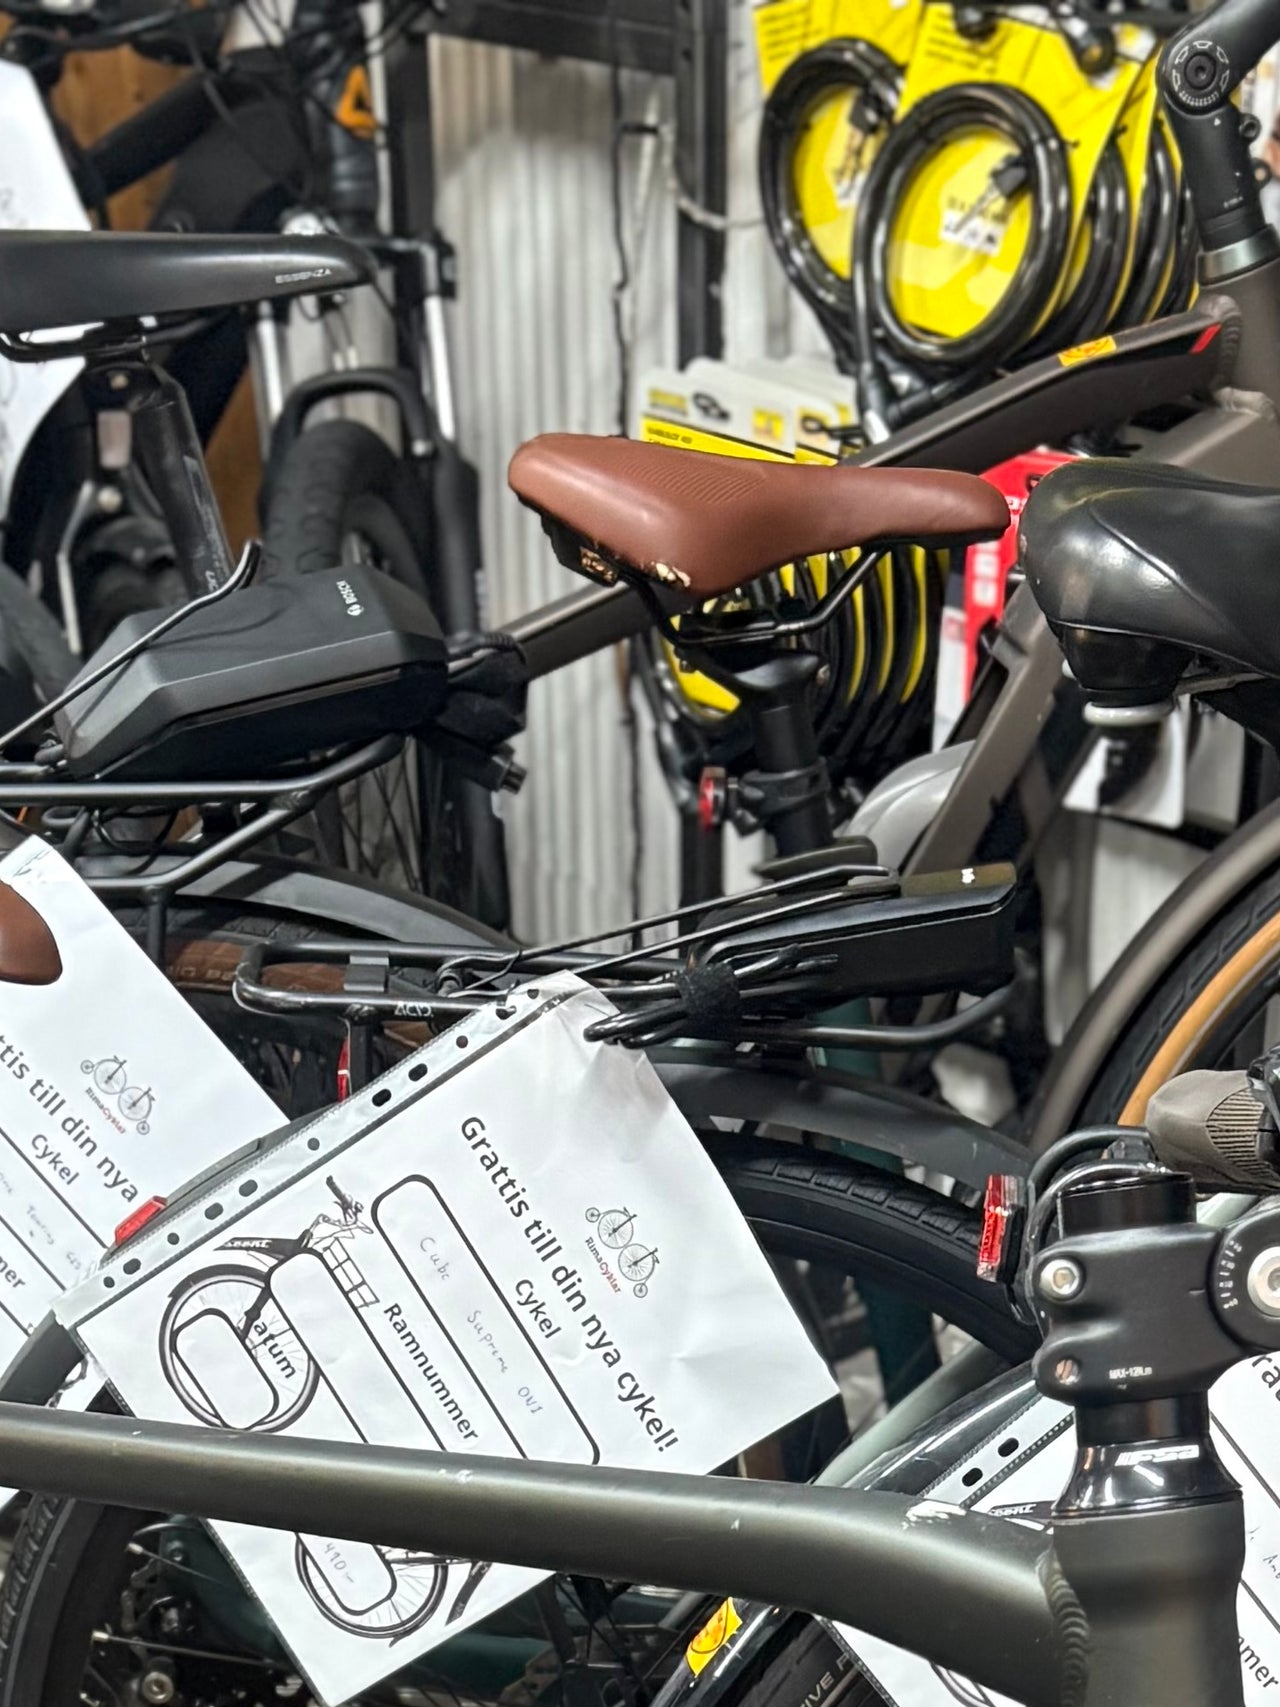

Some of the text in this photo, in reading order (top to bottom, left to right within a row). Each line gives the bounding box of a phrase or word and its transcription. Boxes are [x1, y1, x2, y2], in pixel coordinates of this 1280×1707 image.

[336, 580, 358, 604] BOSCH
[29, 1078, 67, 1117] till
[61, 1114, 99, 1158] din
[96, 1155, 140, 1203] nya
[31, 1133, 80, 1186] Cykel
[460, 1116, 680, 1453] Grattis till din nya cykel!
[515, 1278, 562, 1339] Cykel
[251, 1319, 297, 1380] atum
[383, 1302, 479, 1443] Ramnummer
